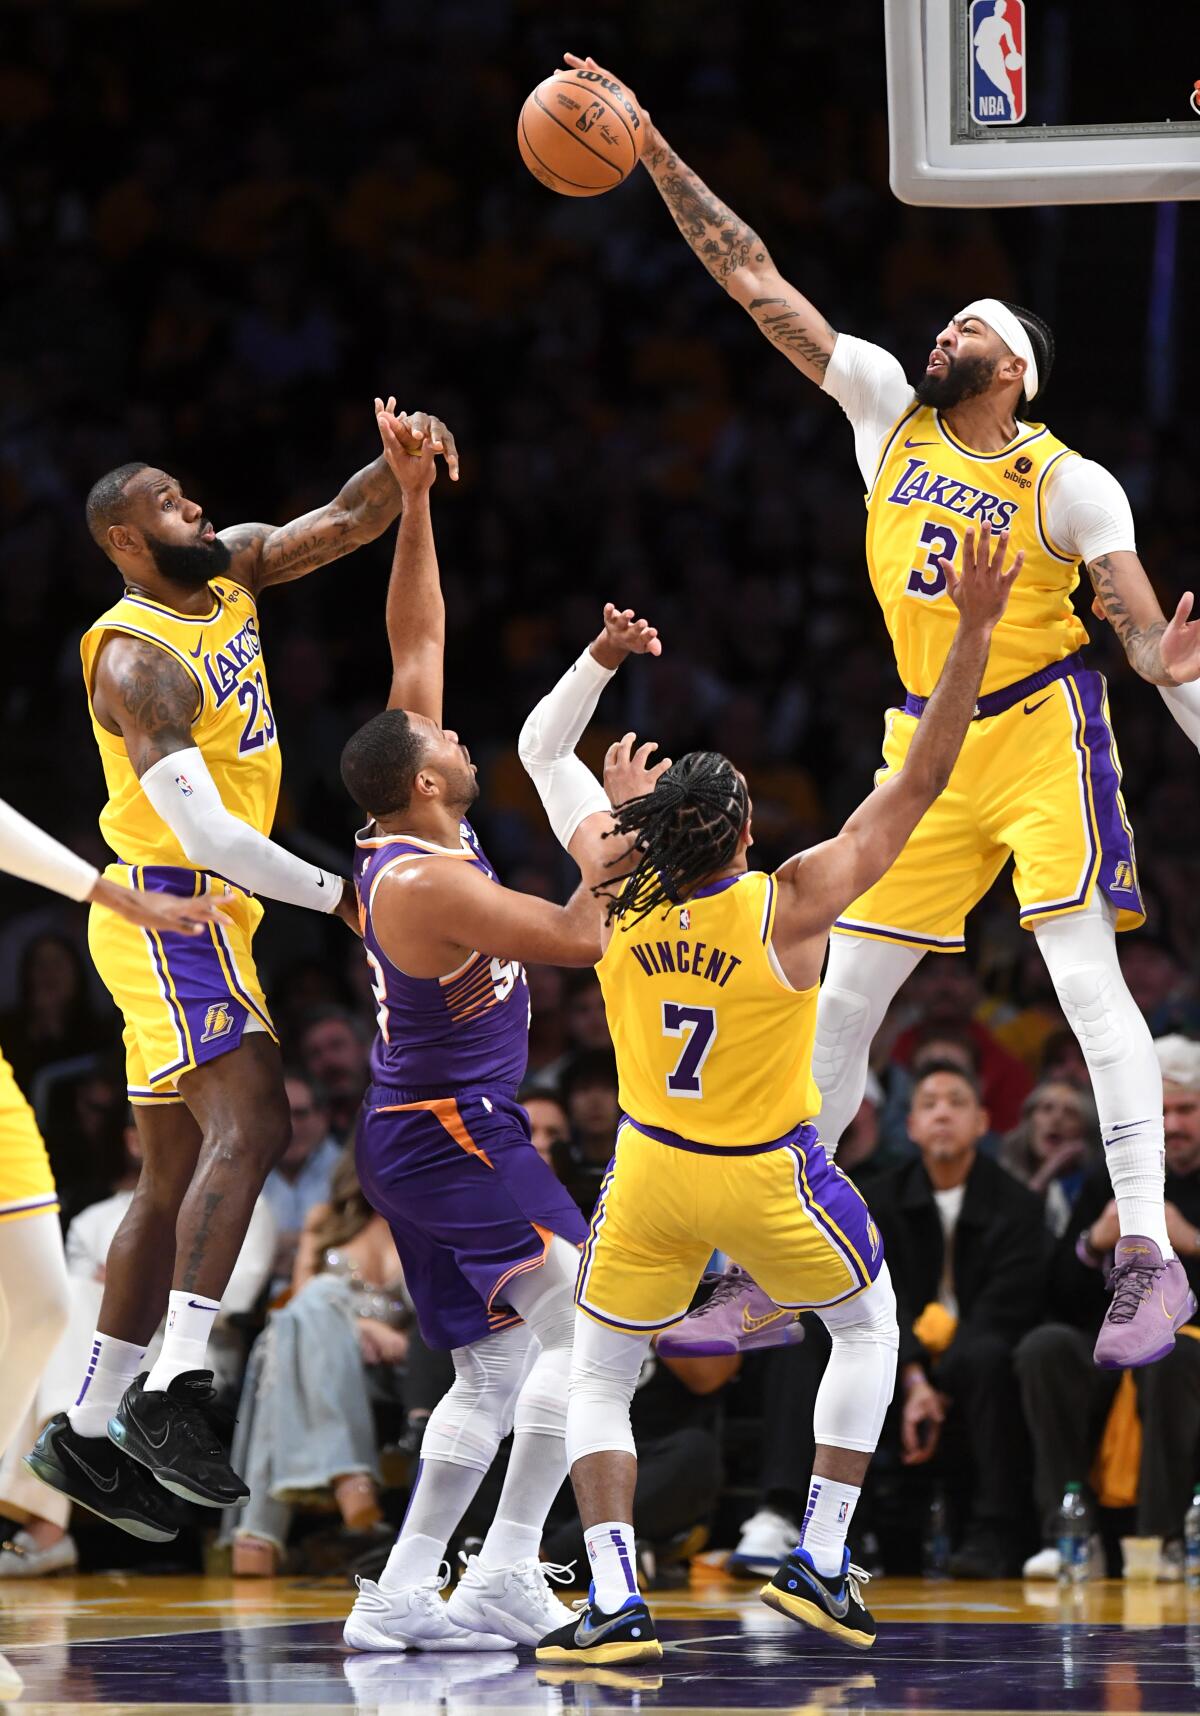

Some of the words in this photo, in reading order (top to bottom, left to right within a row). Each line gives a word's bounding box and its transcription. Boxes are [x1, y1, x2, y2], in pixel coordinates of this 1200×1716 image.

[979, 95, 1005, 116] NBA
[887, 458, 1019, 532] LAKERS
[1003, 469, 1032, 488] bibigo
[907, 521, 958, 597] 3
[203, 617, 260, 709] LAKS
[238, 671, 276, 755] 23
[630, 941, 742, 987] VINCENT
[662, 1001, 717, 1097] 7
